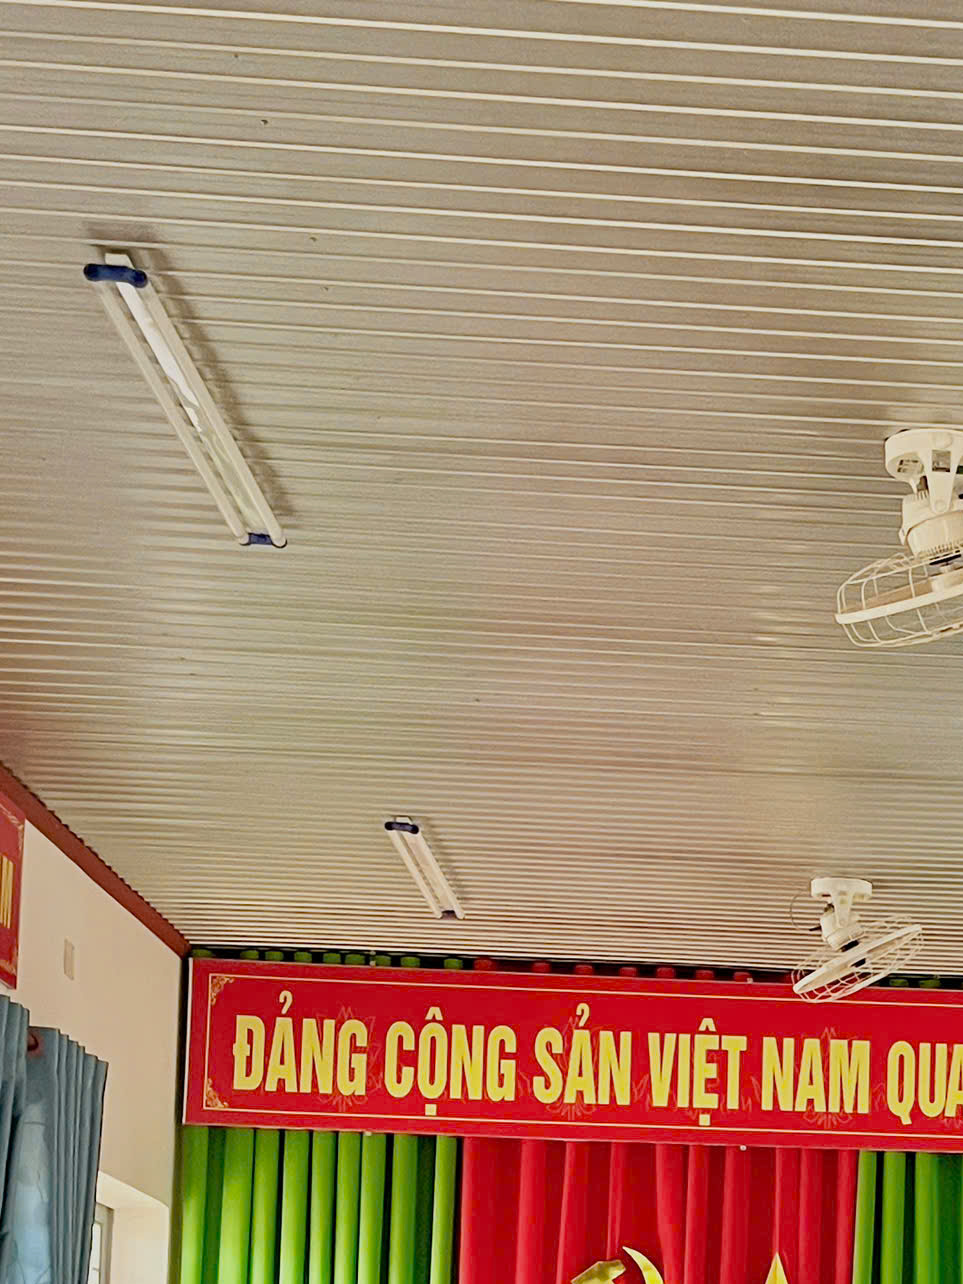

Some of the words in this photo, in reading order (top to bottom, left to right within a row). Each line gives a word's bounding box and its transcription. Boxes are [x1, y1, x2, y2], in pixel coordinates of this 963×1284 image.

[233, 991, 368, 1097] ĐẢNG
[384, 1006, 516, 1117] CỘNG
[533, 1003, 631, 1106] SẢN
[648, 1018, 748, 1127] VIỆT
[761, 1036, 871, 1115] NAM
